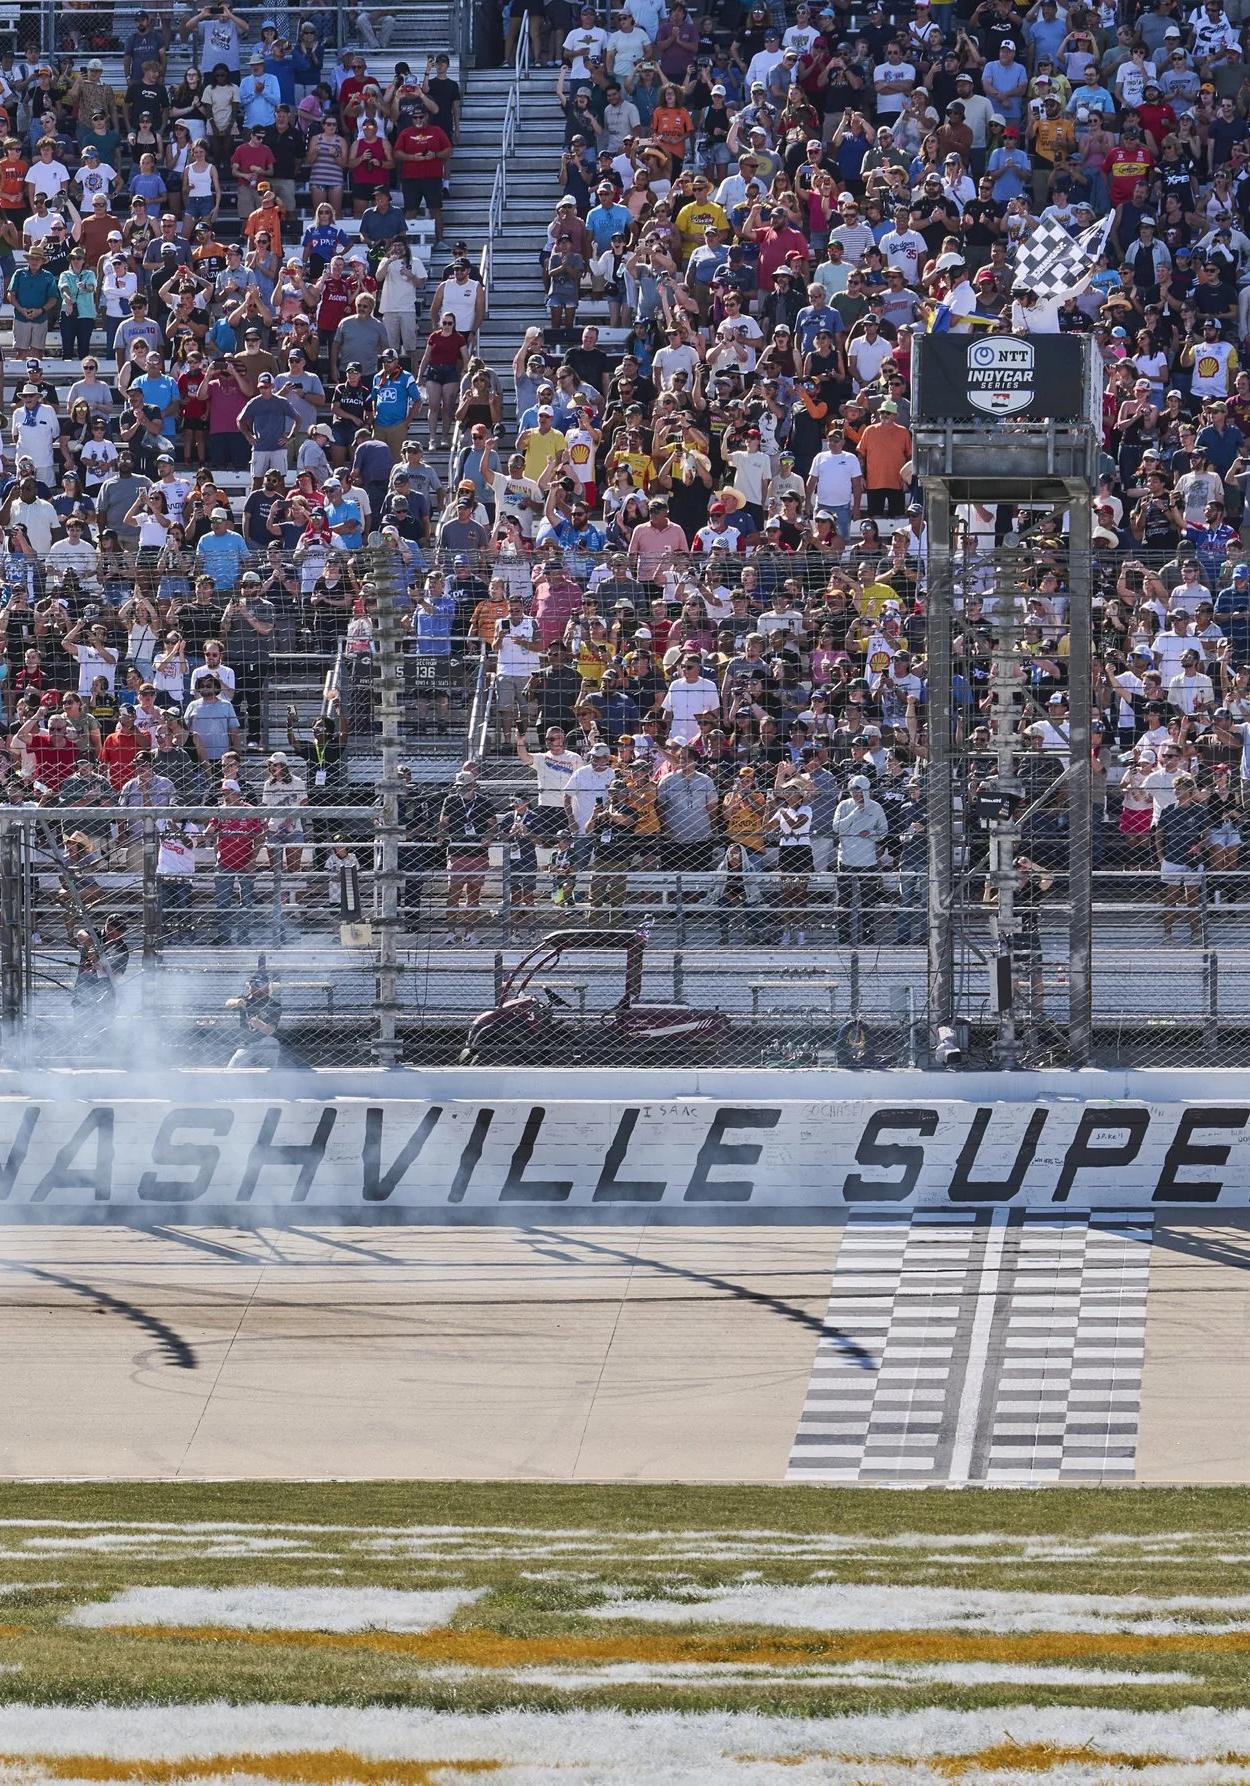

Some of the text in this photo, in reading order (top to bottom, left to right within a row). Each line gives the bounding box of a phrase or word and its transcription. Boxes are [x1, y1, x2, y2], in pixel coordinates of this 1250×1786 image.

[889, 241, 915, 253] Dodgers
[906, 248, 917, 260] 35
[998, 350, 1028, 362] NTT
[967, 370, 1034, 382] INDYCAR
[416, 666, 436, 678] 136
[527, 1011, 535, 1021] 3
